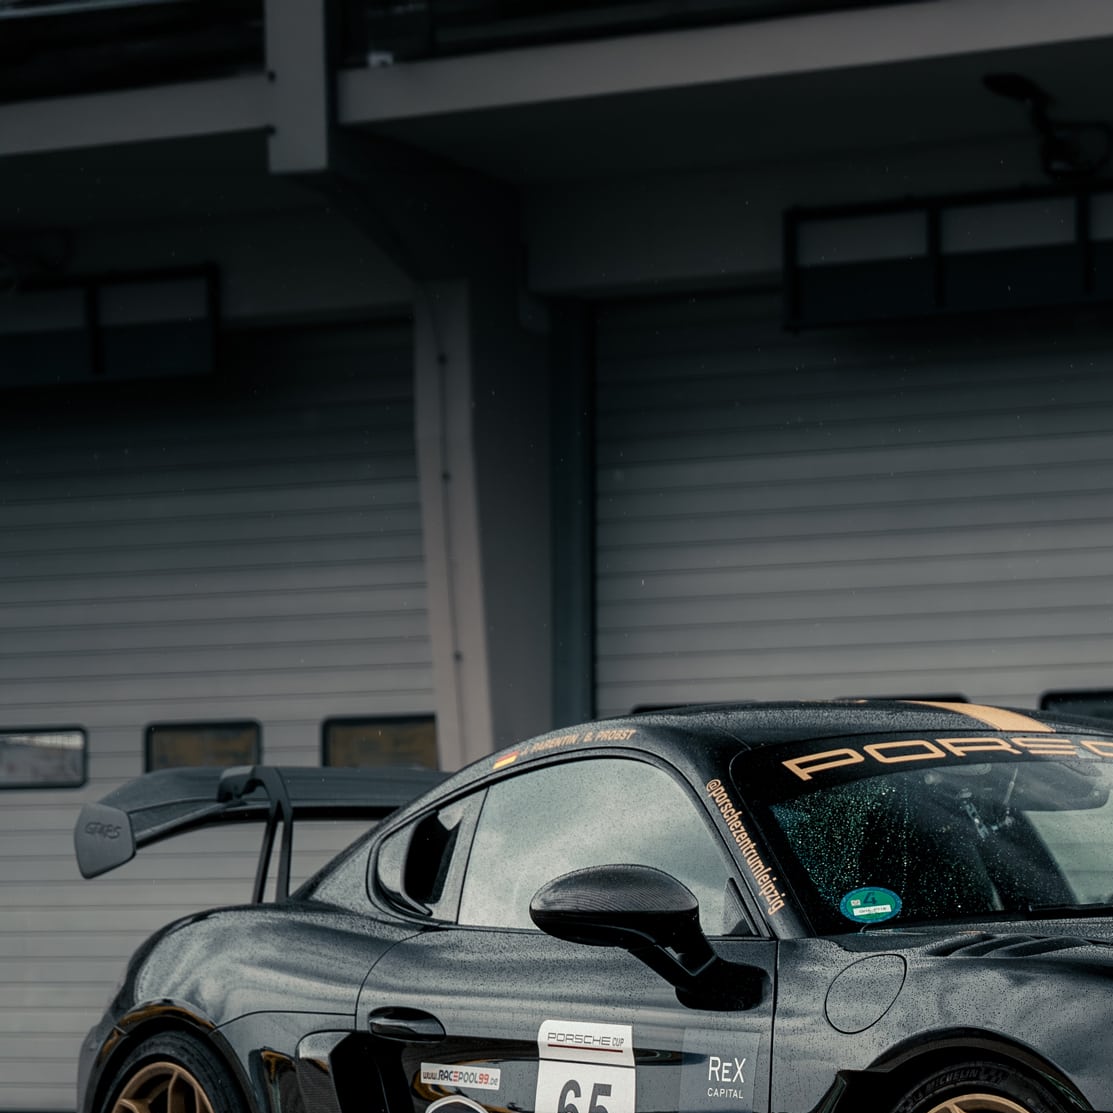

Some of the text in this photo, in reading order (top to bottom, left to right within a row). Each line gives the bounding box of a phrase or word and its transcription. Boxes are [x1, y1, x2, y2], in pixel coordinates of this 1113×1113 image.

[705, 778, 786, 916] @porschezentrumleipzig
[547, 1032, 625, 1047] PORSCHE CUP
[707, 1087, 744, 1099] CAPITAL
